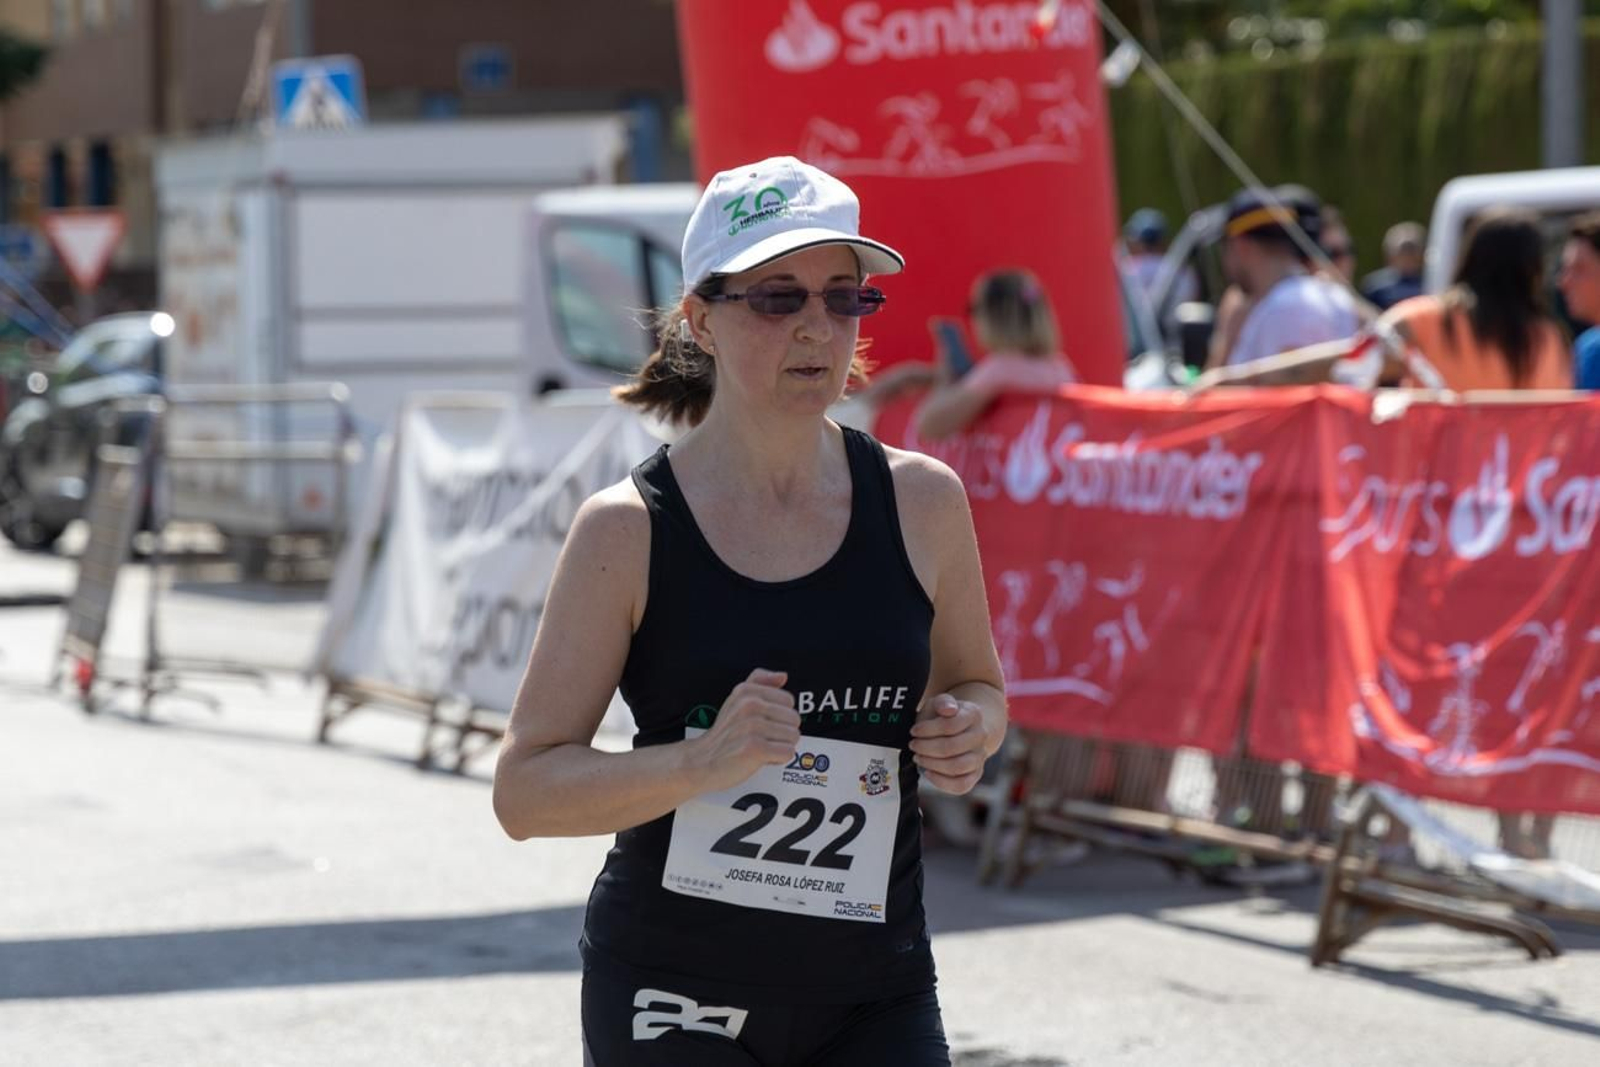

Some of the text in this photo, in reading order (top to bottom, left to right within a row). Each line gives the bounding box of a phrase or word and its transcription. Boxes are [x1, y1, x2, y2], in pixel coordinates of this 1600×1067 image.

[798, 686, 908, 714] BALIFE
[782, 777, 827, 788] NACIONAL
[709, 792, 867, 871] 222
[725, 868, 846, 895] JOSEFA ROSA LÓPEZ RUIZ
[833, 907, 882, 919] NACIONAL
